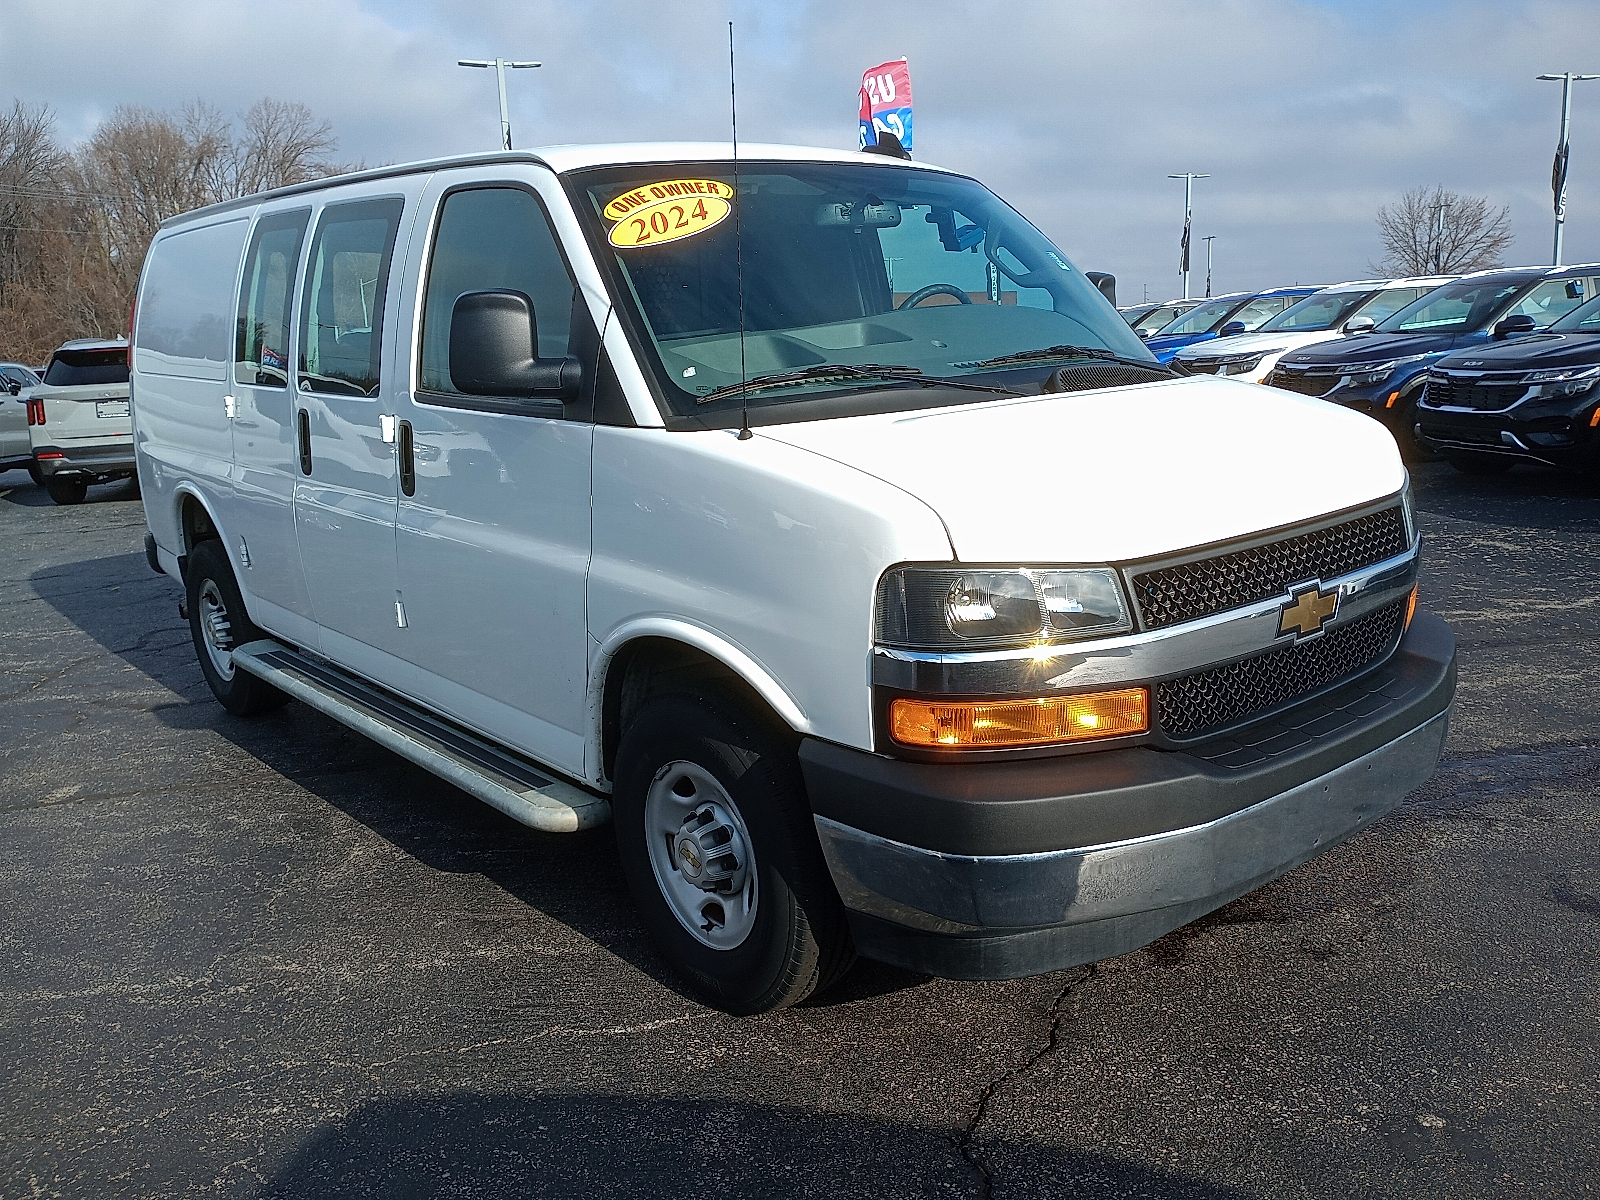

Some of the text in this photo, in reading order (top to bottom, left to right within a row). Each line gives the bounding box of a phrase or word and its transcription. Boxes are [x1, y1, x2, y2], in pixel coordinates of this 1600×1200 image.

[611, 182, 720, 213] ONE OWNER
[630, 198, 709, 244] 2024
